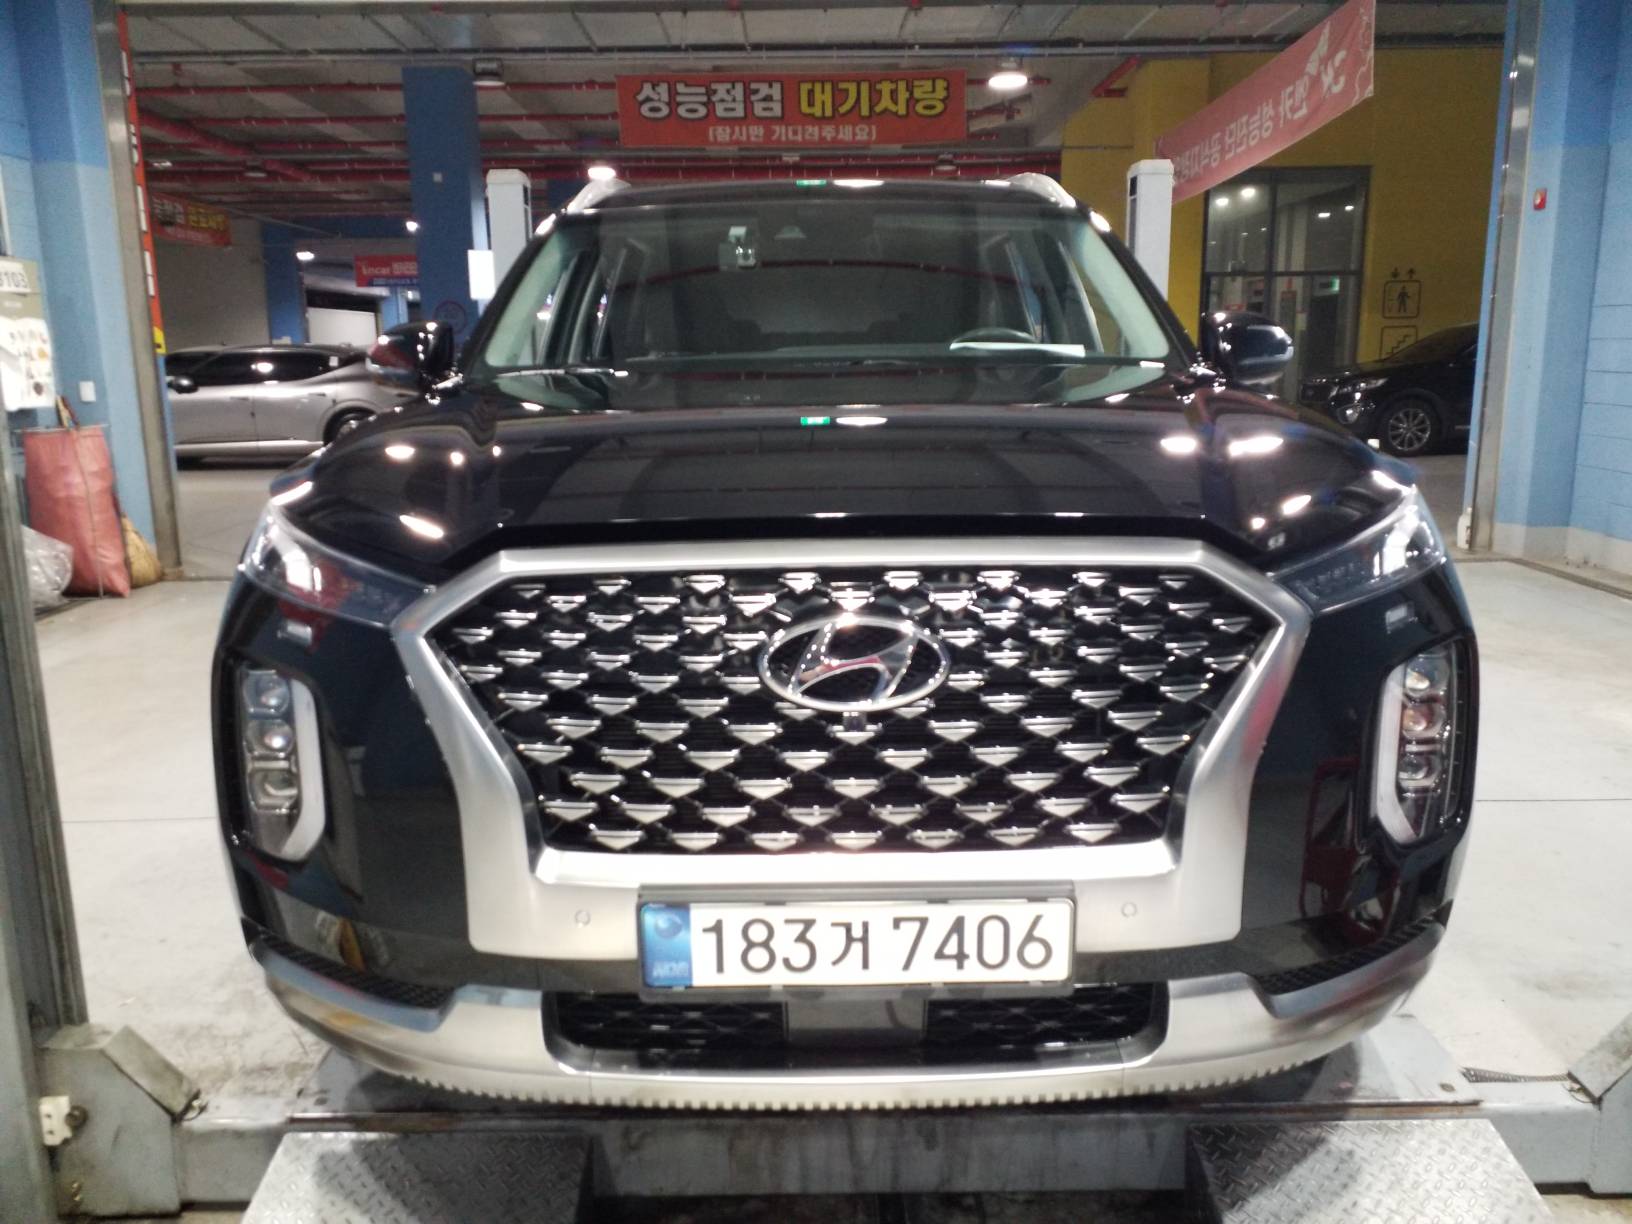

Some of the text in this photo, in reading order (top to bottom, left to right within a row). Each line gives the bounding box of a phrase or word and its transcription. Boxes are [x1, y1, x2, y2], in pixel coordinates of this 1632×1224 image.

[635, 78, 949, 120] 성능점검 대기차량
[891, 914, 1055, 972] 7406
